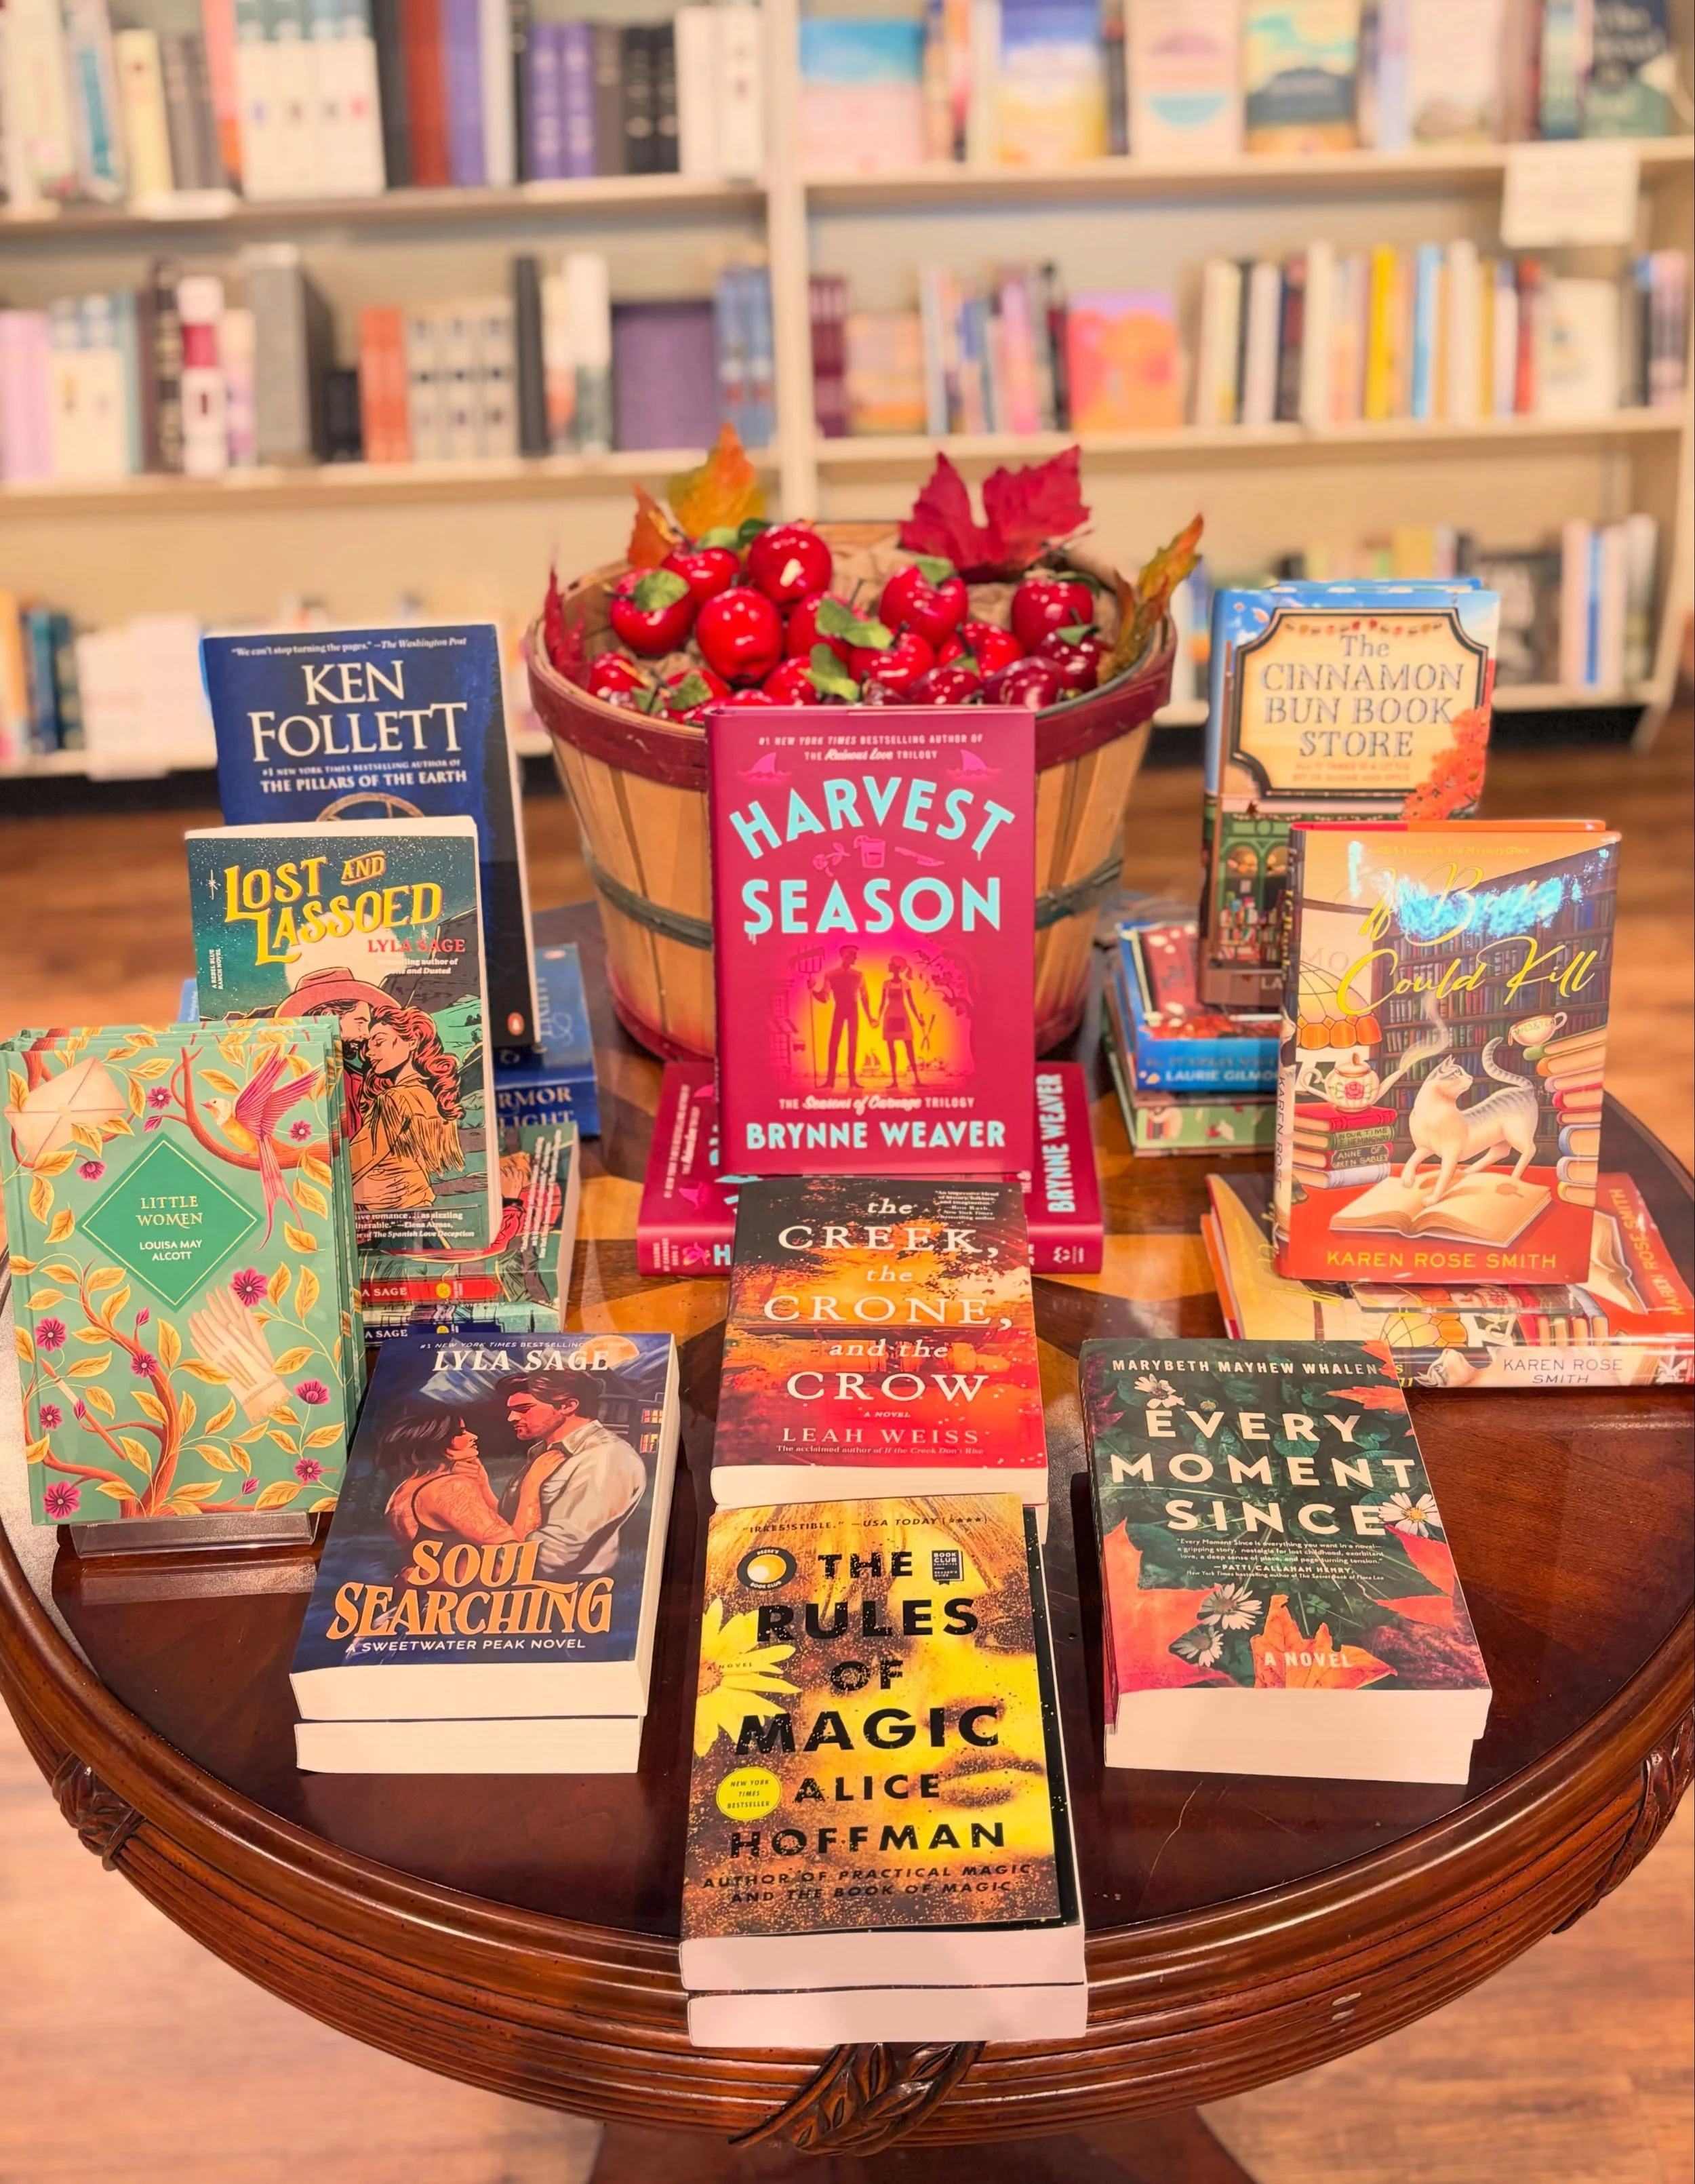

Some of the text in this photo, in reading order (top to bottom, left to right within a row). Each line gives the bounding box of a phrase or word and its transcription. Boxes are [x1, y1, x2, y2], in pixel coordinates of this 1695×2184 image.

[273, 646, 292, 656] stop
[294, 644, 326, 654] turning
[327, 643, 340, 652] the
[399, 639, 447, 649] Washington
[449, 637, 467, 646] Post
[1340, 635, 1390, 657] The
[302, 660, 405, 705] KEN
[1260, 663, 1464, 692] CINNAMON
[1264, 696, 1454, 725] BUN BOOK
[247, 702, 467, 763] FOLLETT
[759, 734, 983, 746] #1 NEW YORK TIMES BESTSELLING AUTHOR OF
[1299, 730, 1414, 758] STORE
[804, 751, 822, 761] THE
[897, 750, 938, 759] TRILOGY
[277, 768, 296, 776] NEW
[299, 766, 322, 774] YORK
[325, 765, 351, 773] TIMES
[353, 762, 409, 772] BESTSELLING
[411, 760, 447, 768] AUTHOR
[260, 770, 467, 793] THE PILLARS OF THE EARTH
[729, 776, 1016, 860] HARVEST
[224, 853, 386, 922] LOST AND
[742, 877, 1001, 942] SEASON
[256, 882, 443, 966] LASSOED
[367, 939, 466, 953] LYLA SAGE
[1336, 936, 1597, 1016] Could Kill
[499, 1086, 572, 1109] RMOR
[779, 1098, 799, 1109] THE
[853, 1095, 869, 1116] of
[925, 1096, 975, 1108] TRILOGY
[746, 1120, 1006, 1150] BRYNNE WEAVER
[1035, 1073, 1076, 1213] BRYNNE WEAVER
[1338, 1146, 1382, 1159] ANNE OF
[140, 1195, 198, 1210] LITTLE
[867, 1197, 914, 1215] the
[136, 1212, 203, 1229] WOMEN
[140, 1239, 203, 1250] LOUISA MAY
[778, 1225, 999, 1258] CREEK,
[152, 1251, 191, 1261] ALCOTT
[1327, 1251, 1556, 1269] KAREN ROSE SMITH
[866, 1265, 914, 1283] the
[374, 1288, 407, 1296] SAGE
[1651, 1274, 1686, 1315] KAREN
[763, 1295, 1013, 1330] CRONE,
[376, 1330, 407, 1338] SAGE
[829, 1338, 949, 1358] and the
[432, 1349, 610, 1372] LYLA SAGE
[1112, 1359, 1379, 1375] MARYBETH MAYHEW WHALEN
[1504, 1359, 1623, 1371] KAREN ROSE
[786, 1371, 989, 1402] CROW
[1532, 1374, 1589, 1384] SMITH
[782, 1427, 979, 1444] LEAH WEISS
[1144, 1410, 1361, 1443] EVERY
[1109, 1452, 1415, 1488] MOMENT
[896, 1517, 937, 1525] TODAY
[1165, 1499, 1387, 1536] SINCE
[1262, 1541, 1302, 1549] everything
[1304, 1549, 1344, 1557] childhood,
[407, 1540, 579, 1593] SOUL
[818, 1551, 913, 1579] THE
[326, 1577, 614, 1640] SEARCHING
[756, 1597, 979, 1642] RULES
[345, 1638, 586, 1652] A SWEETWATER PEAK NOVEL
[1264, 1652, 1353, 1669] A NOVEL
[831, 1659, 904, 1691] OF
[735, 1705, 999, 1755] MAGIC
[794, 1772, 941, 1804] ALICE
[727, 1801, 770, 1809] BESTSELLER
[730, 1822, 1005, 1859] HOFFMAN
[702, 1863, 1032, 1889] AUTHOR OF PRACTICAL MAGIC
[731, 1880, 1012, 1904] AND THE BOOK OF MAGIC
